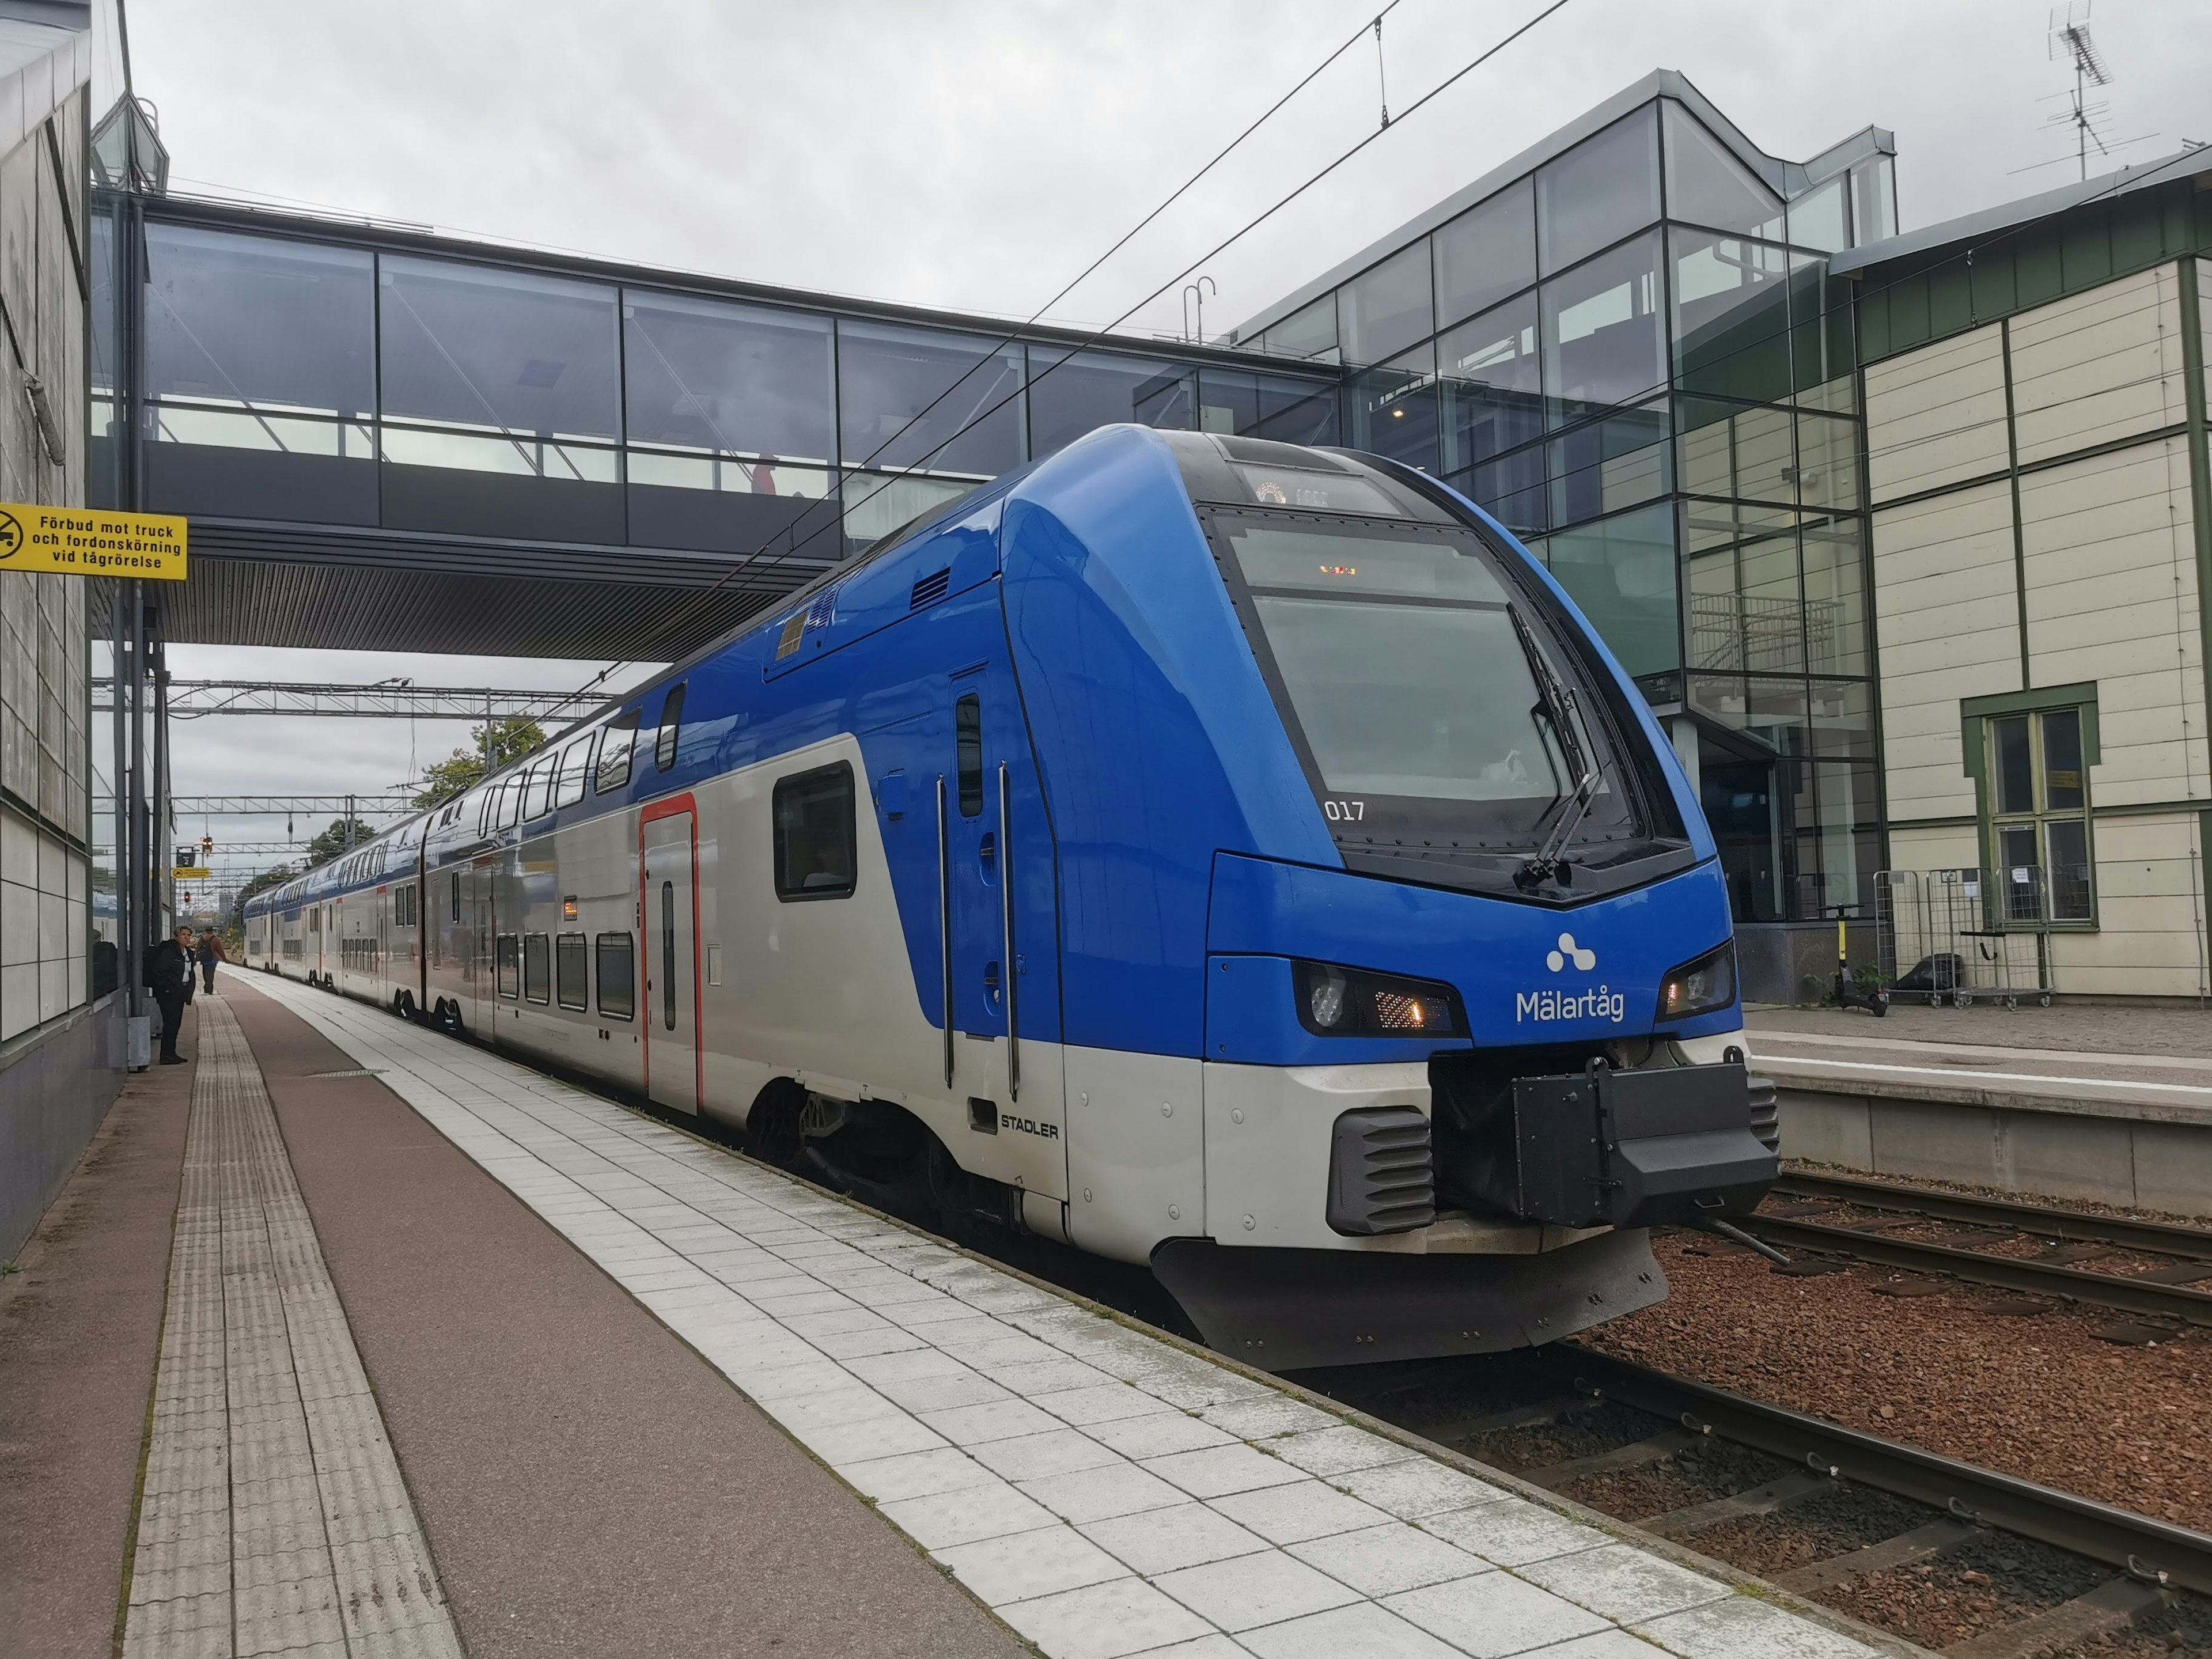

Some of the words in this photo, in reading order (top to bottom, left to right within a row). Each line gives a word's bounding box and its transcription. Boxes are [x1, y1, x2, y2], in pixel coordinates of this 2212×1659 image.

[40, 516, 93, 531] Förbud
[101, 523, 128, 534] mot
[135, 524, 173, 537] truck
[32, 533, 59, 544] och
[66, 534, 180, 556] fordonskörning
[52, 550, 75, 562] vid
[83, 552, 162, 568] tågrörelse
[1324, 801, 1364, 820] 017
[1516, 984, 1624, 1022] Mälartåg
[1001, 1114, 1059, 1140] STADLER
